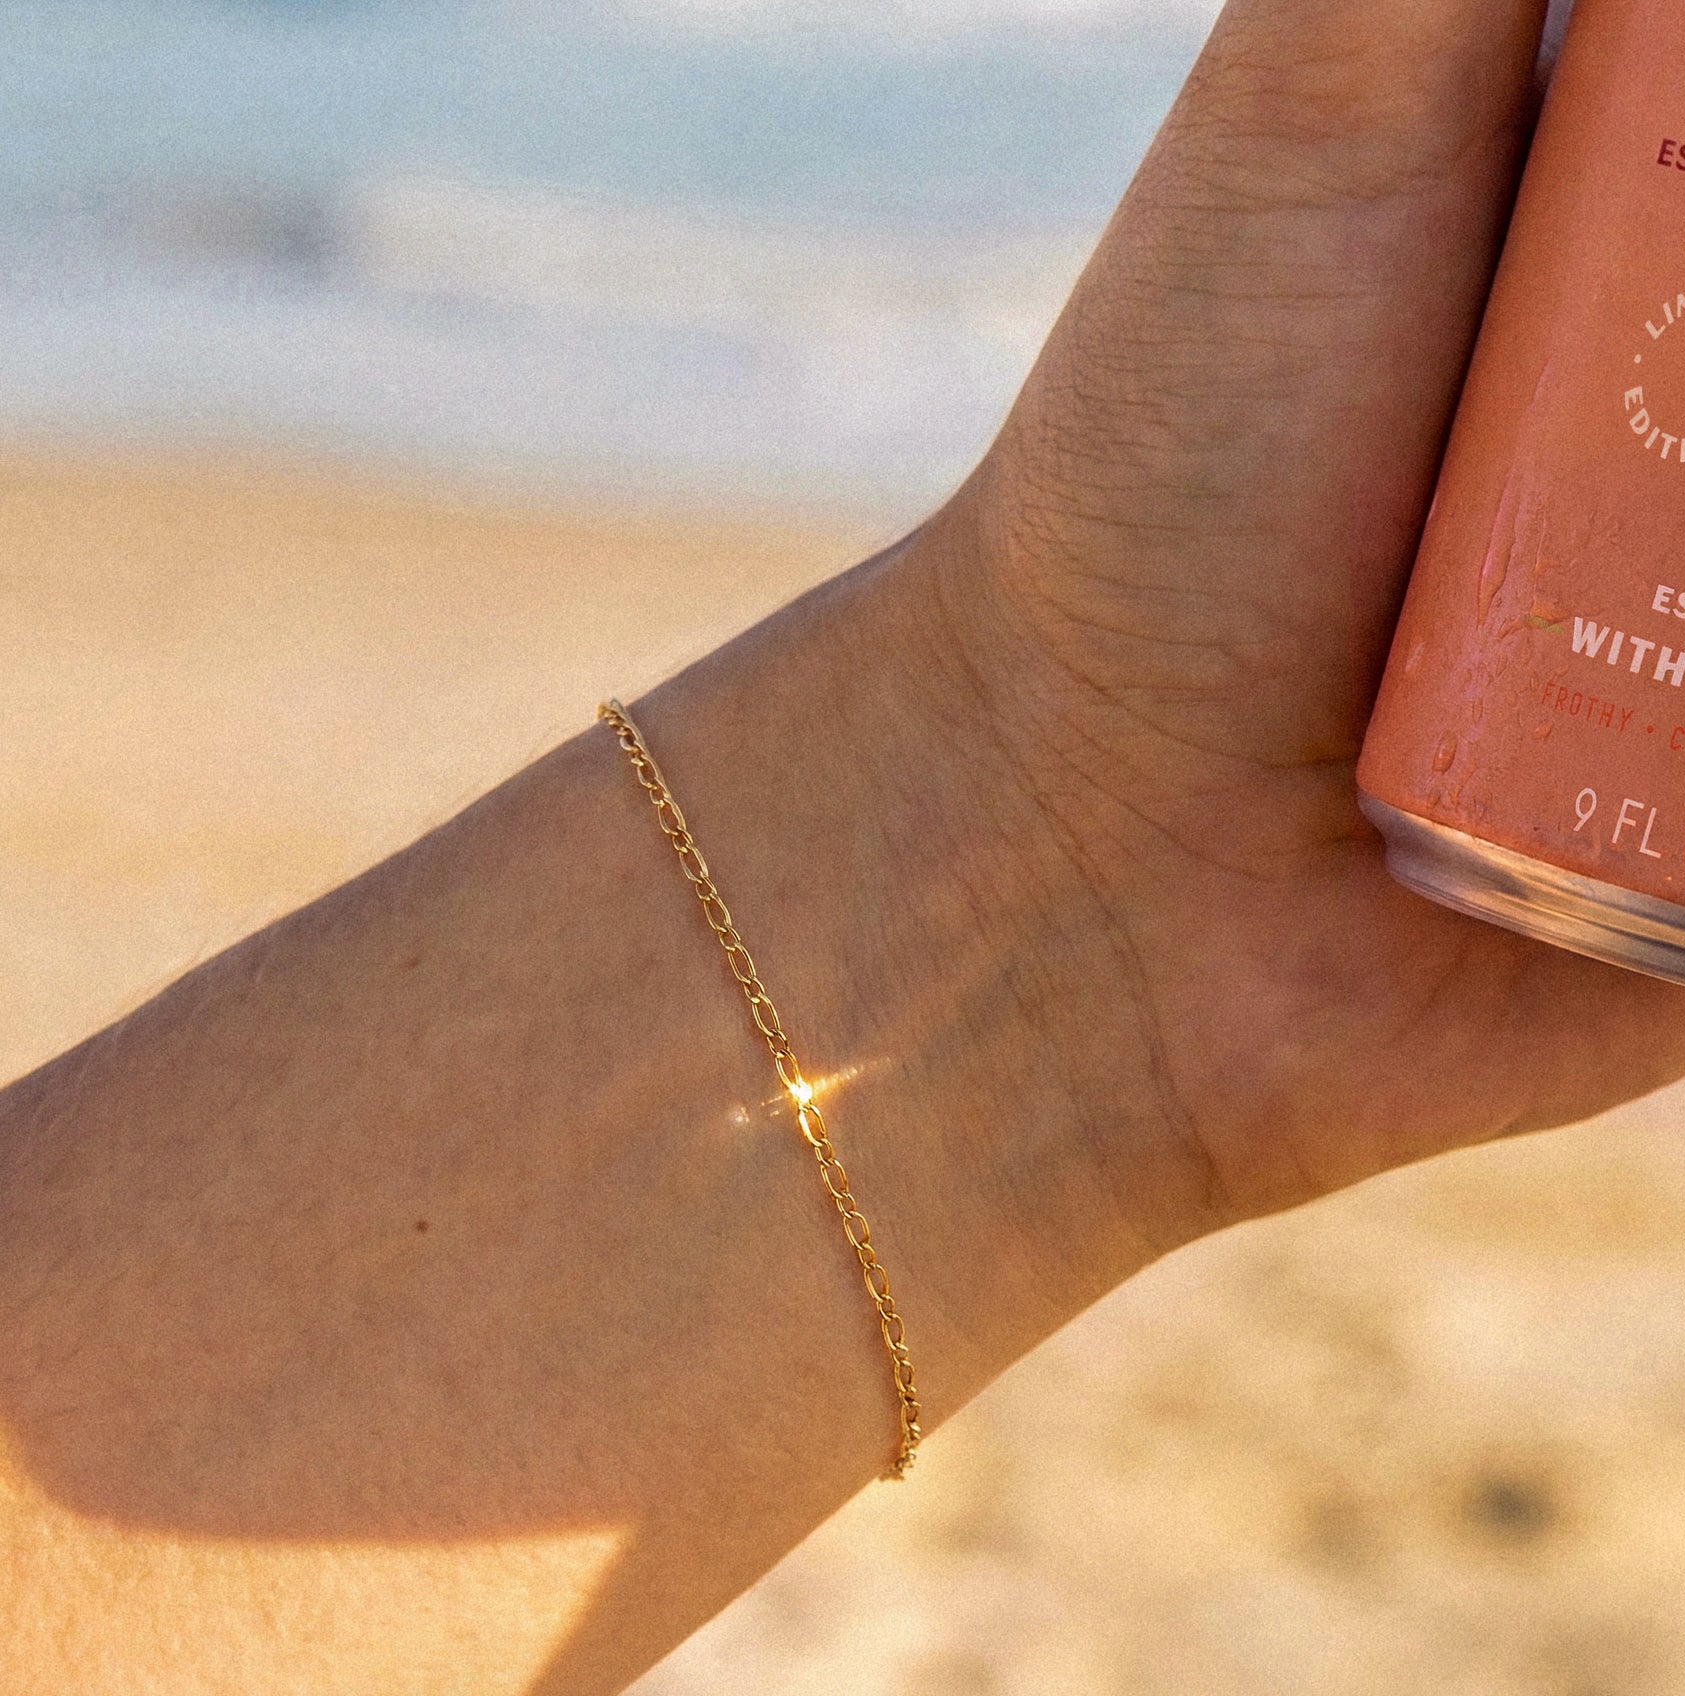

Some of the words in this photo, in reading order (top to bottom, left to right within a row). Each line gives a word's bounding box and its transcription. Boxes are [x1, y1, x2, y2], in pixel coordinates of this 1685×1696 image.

[1540, 680, 1634, 733] FROTHY
[1573, 787, 1598, 833] 9
[1611, 798, 1661, 859] FL
